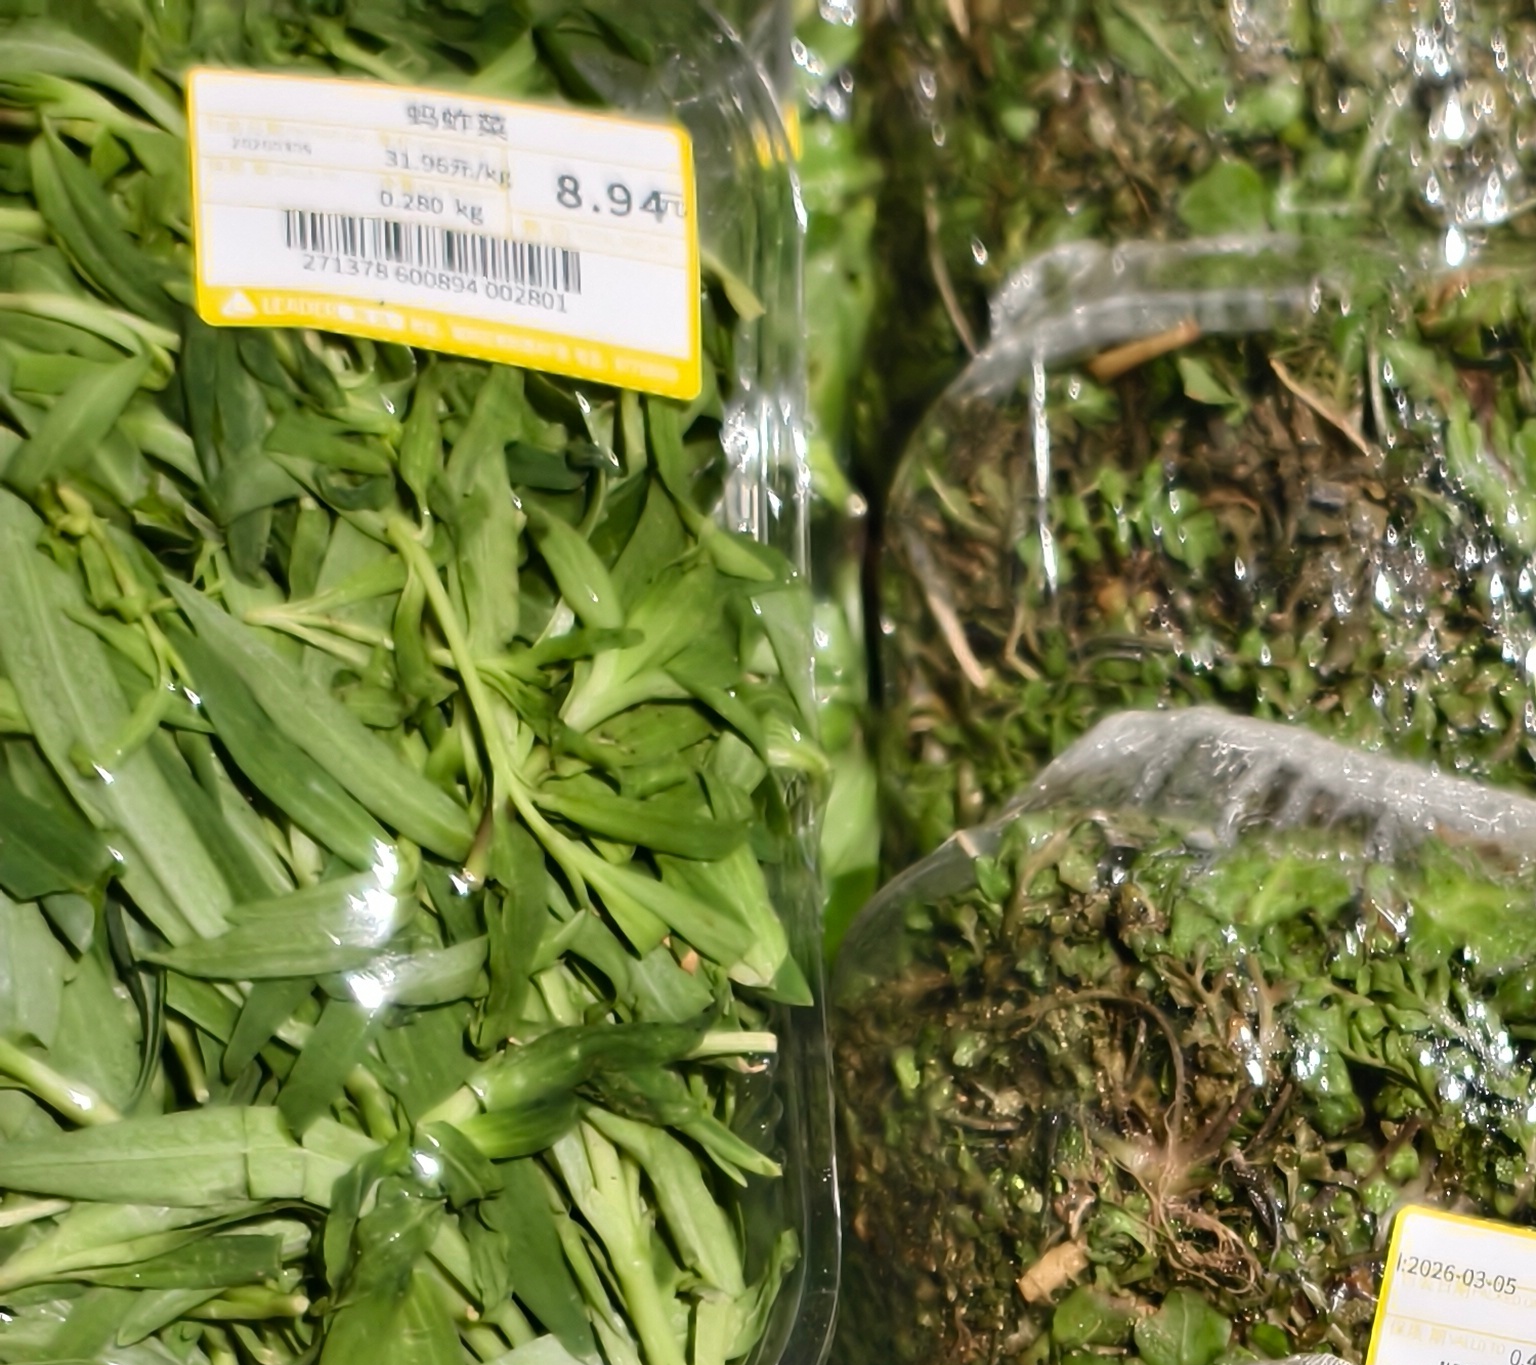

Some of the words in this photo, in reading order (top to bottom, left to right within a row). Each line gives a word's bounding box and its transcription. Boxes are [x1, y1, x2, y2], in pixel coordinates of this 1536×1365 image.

[380, 191, 443, 215] 0.280
[456, 199, 485, 225] kg
[557, 175, 666, 223] 8.94
[303, 253, 388, 281] 271378
[395, 266, 478, 295] 600894
[486, 282, 568, 314] 002801
